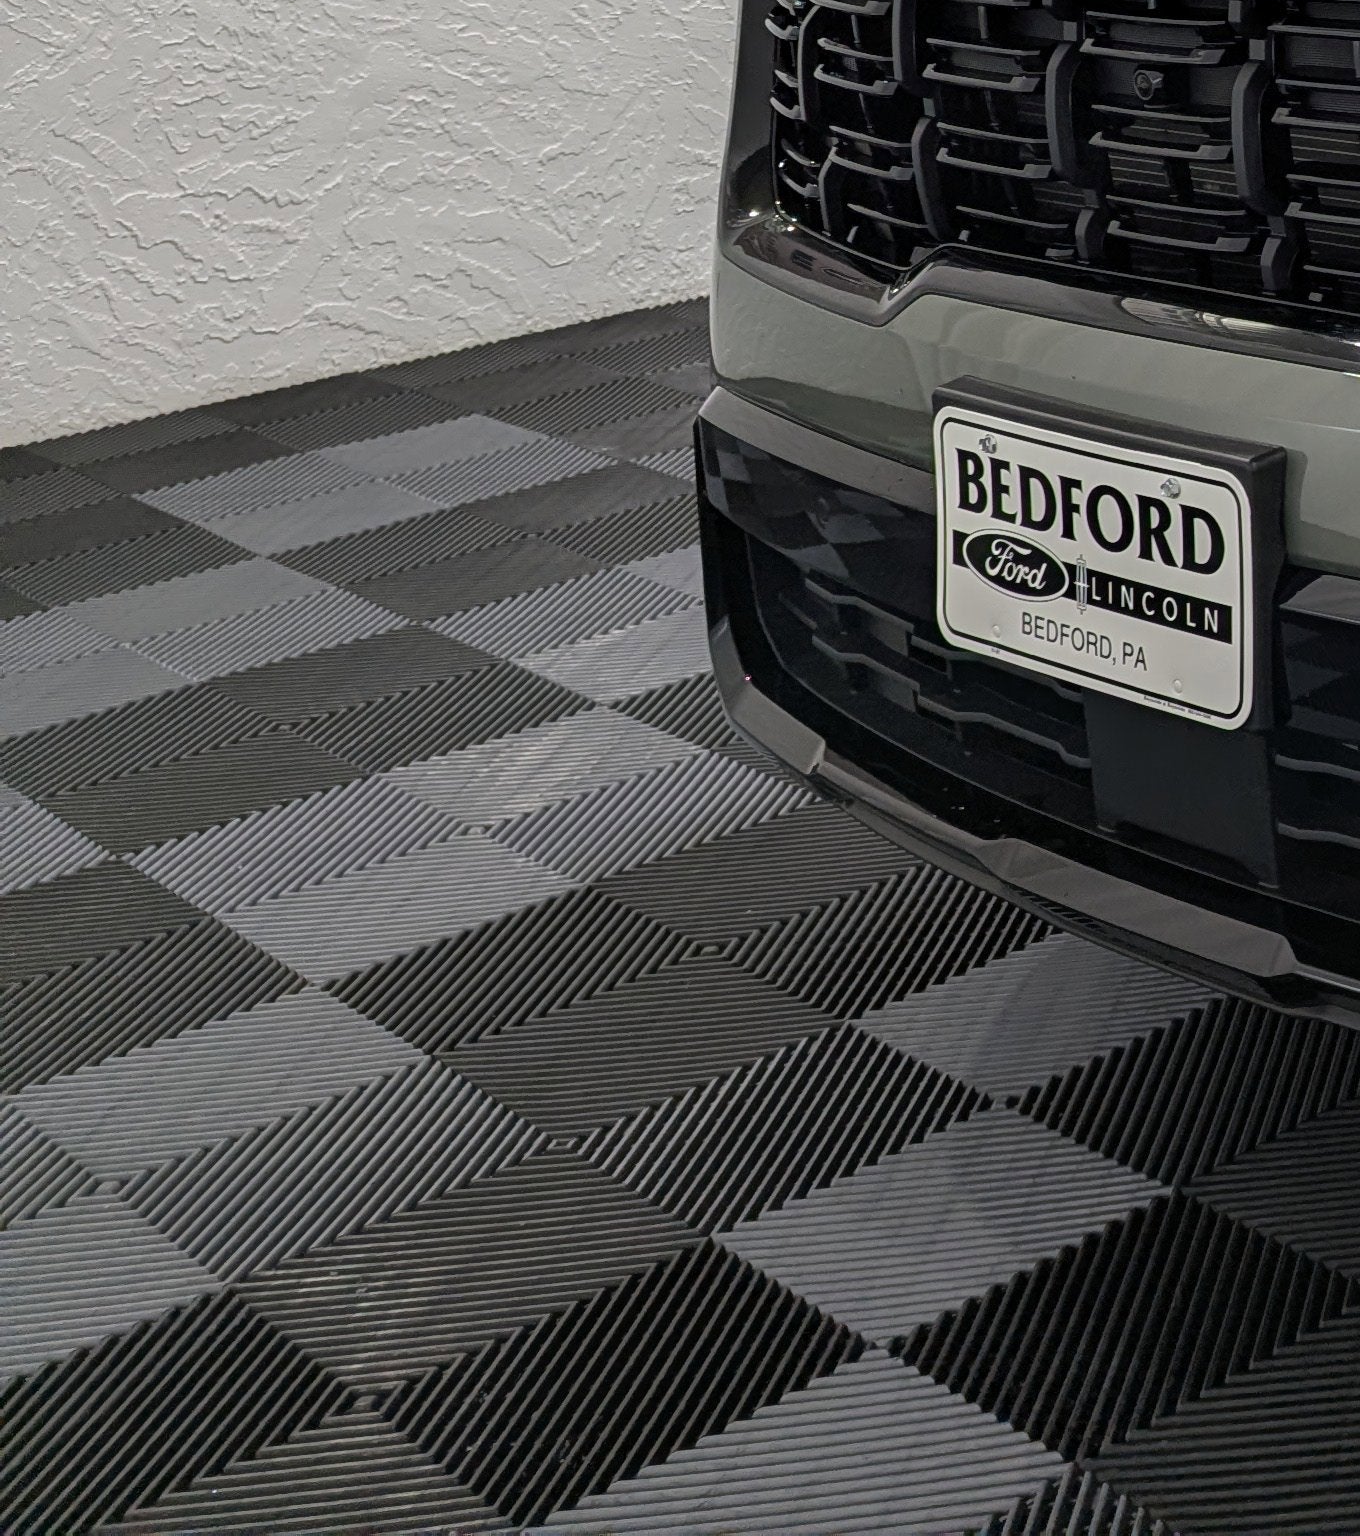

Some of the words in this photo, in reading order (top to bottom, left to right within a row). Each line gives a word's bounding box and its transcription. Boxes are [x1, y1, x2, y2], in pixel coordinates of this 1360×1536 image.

[955, 447, 1226, 576] BEDFORD
[984, 539, 1048, 591] Ford
[1090, 578, 1219, 635] LINCOLN
[1021, 612, 1118, 667] BEDFORD,
[1122, 641, 1149, 672] PA
